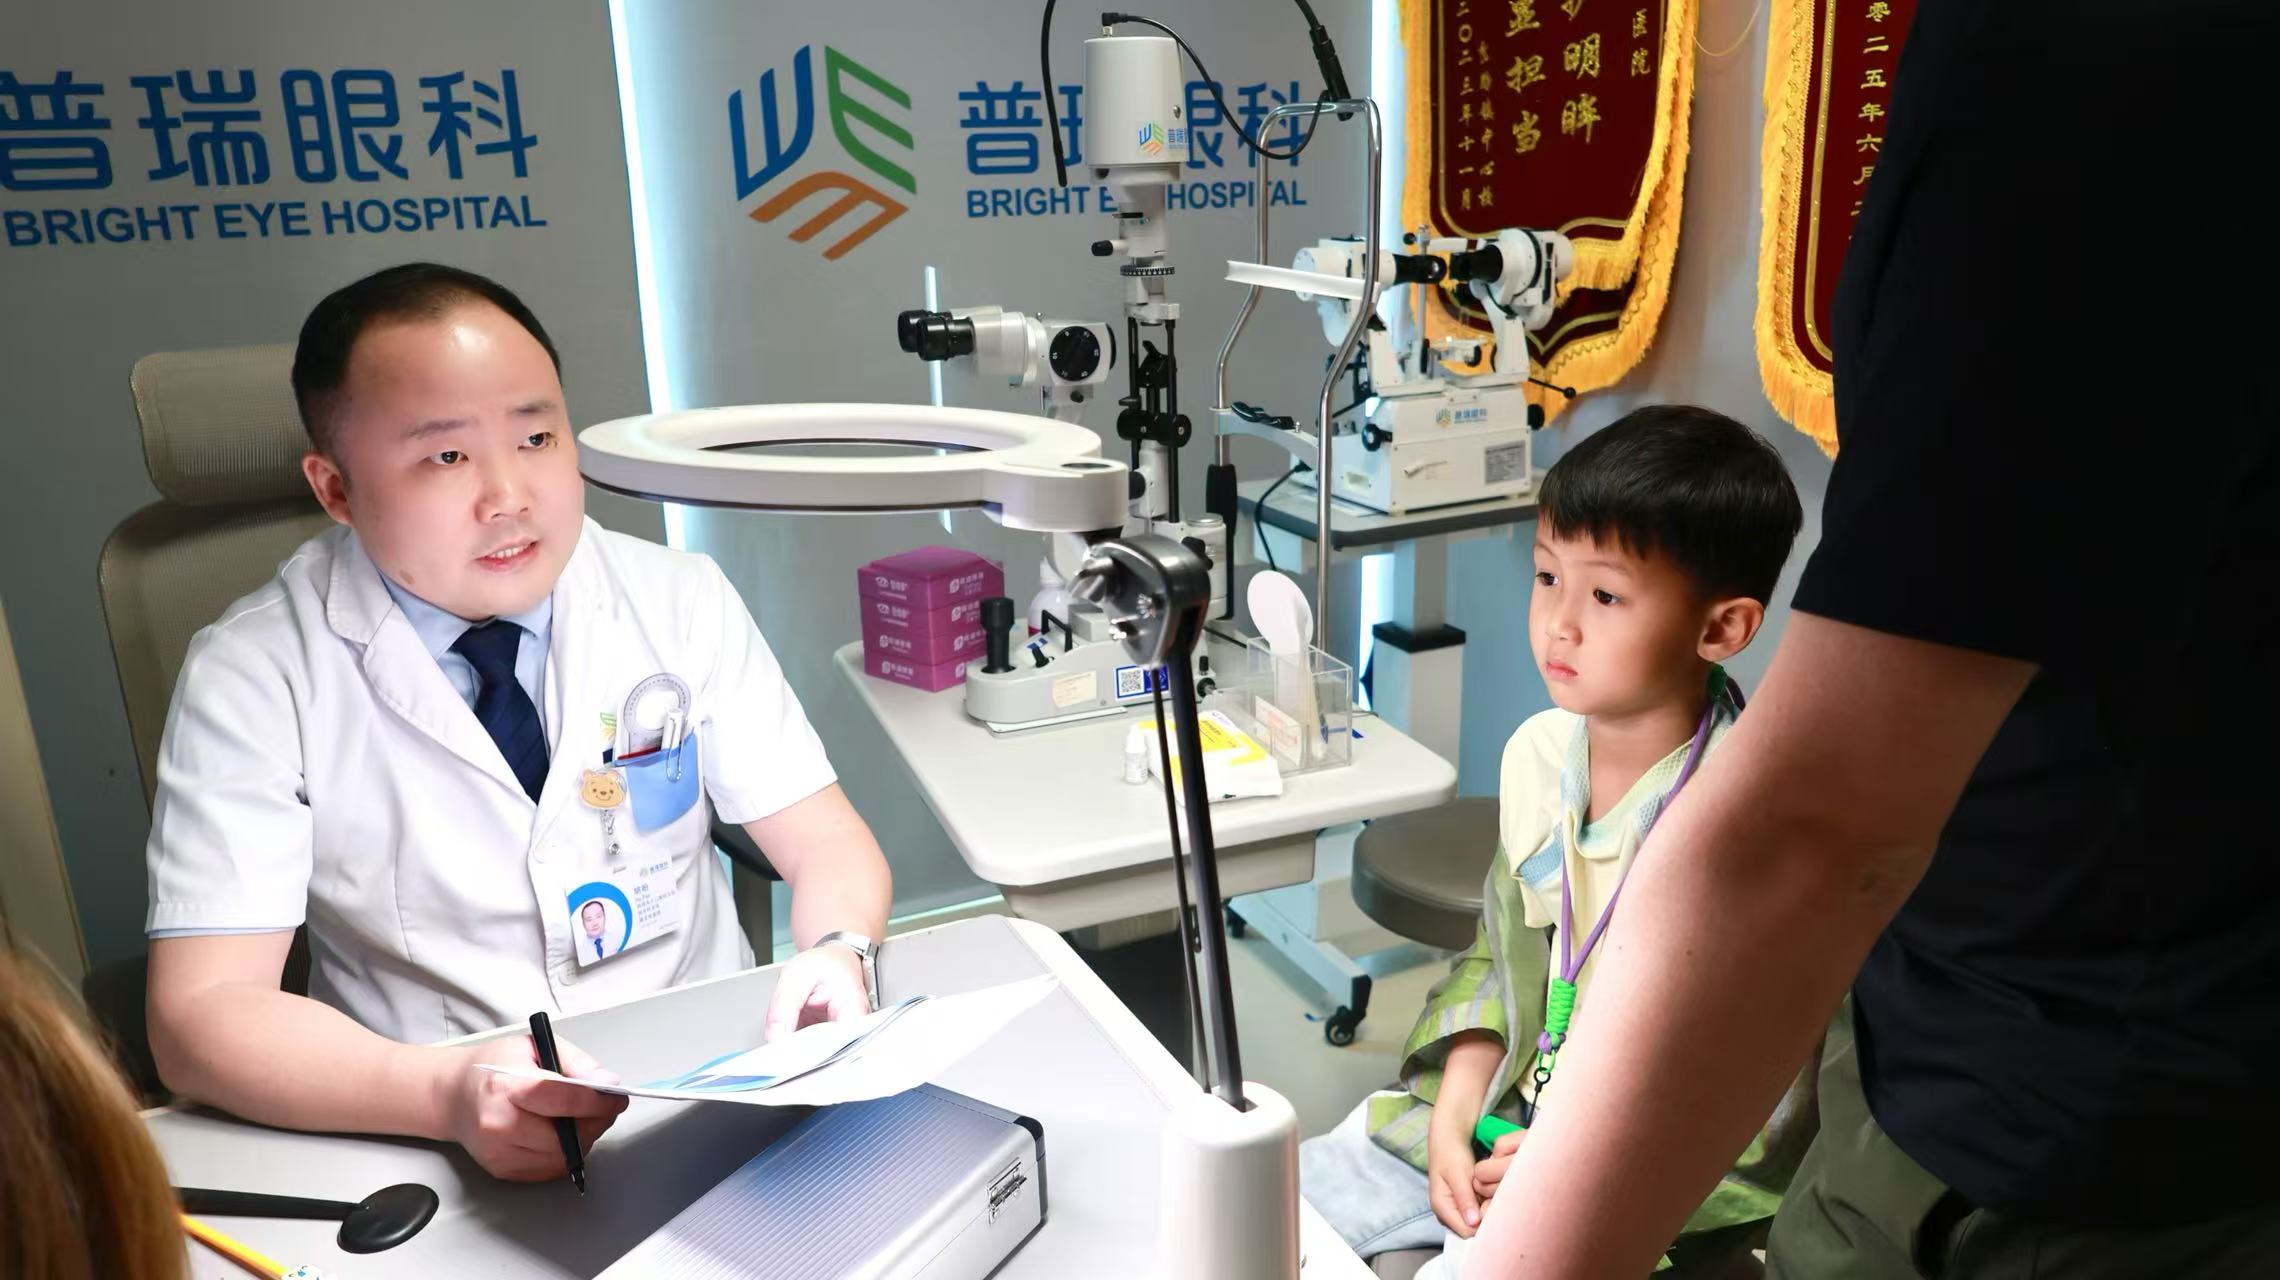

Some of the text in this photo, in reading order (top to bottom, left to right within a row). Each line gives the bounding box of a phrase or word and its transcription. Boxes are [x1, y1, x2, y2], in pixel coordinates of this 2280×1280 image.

[1631, 8, 1651, 77] 医院
[0, 68, 538, 191] 普瑞眼科
[5, 194, 547, 247] BRIGHT EYE HOSPITAL
[966, 185, 1090, 219] BRIGHT
[1167, 180, 1307, 212] HOSPIAL
